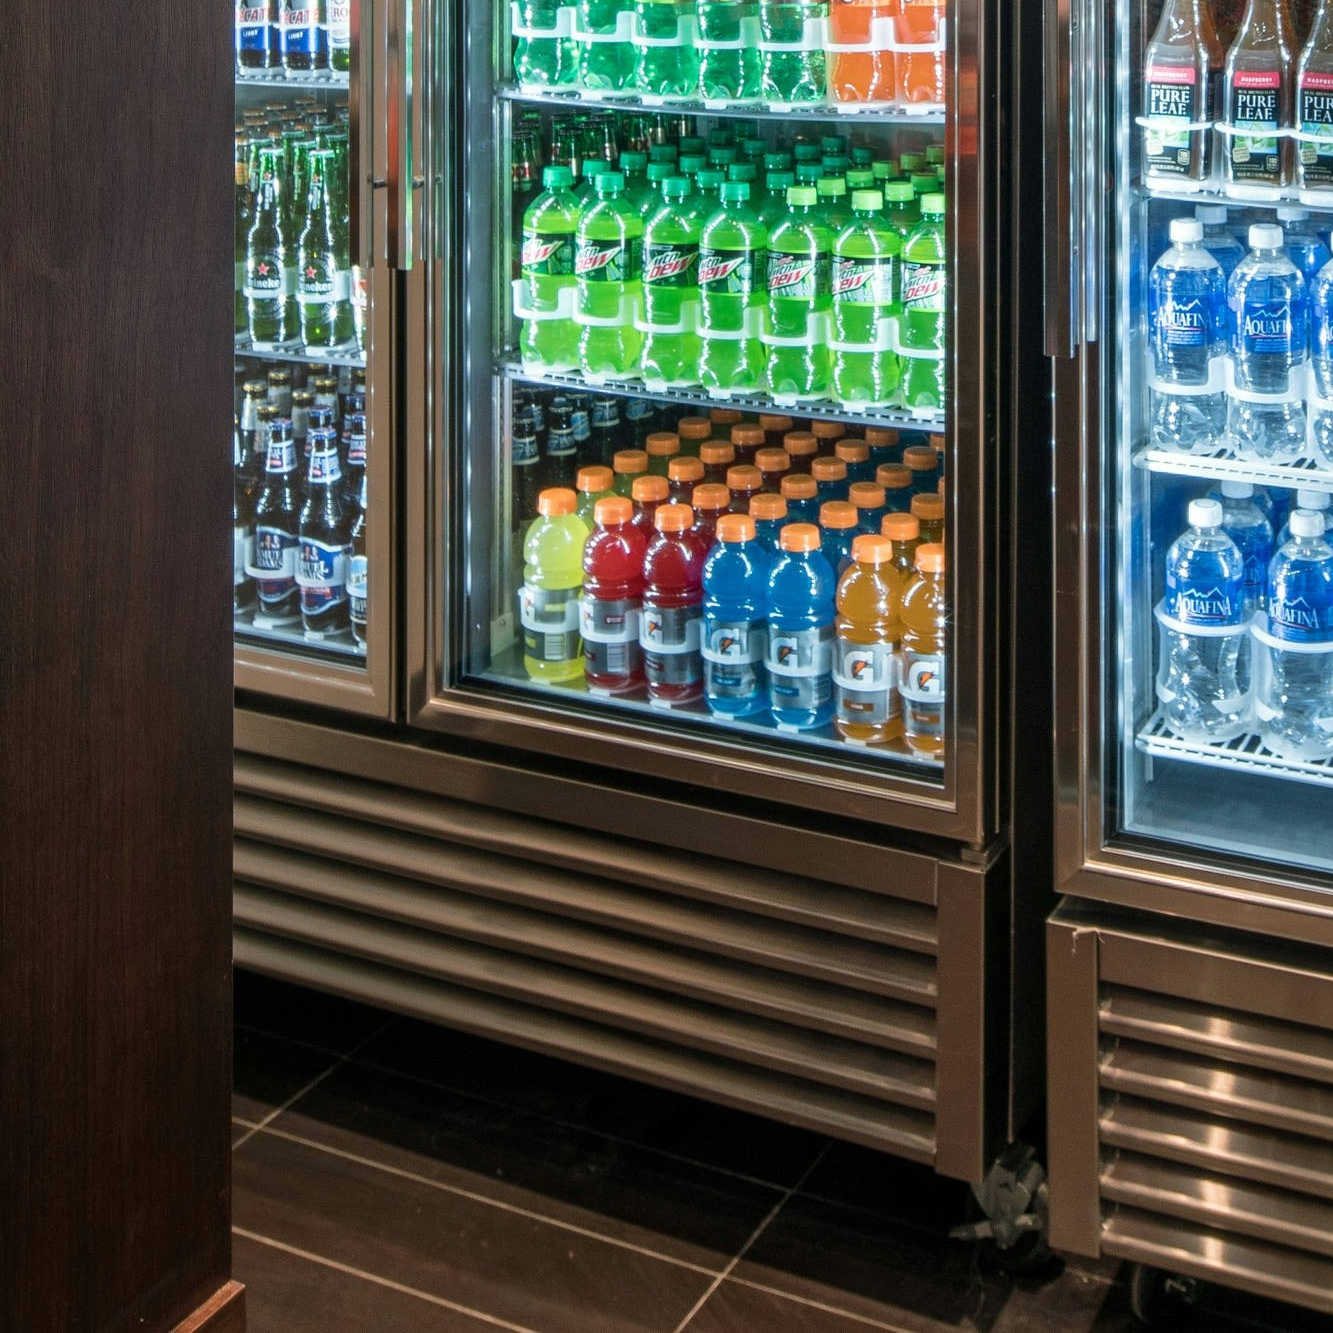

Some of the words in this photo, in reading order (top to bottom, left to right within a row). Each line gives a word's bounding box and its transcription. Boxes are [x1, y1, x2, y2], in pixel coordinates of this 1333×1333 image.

[1150, 89, 1190, 104] PURE
[1237, 94, 1276, 108] PURE
[845, 650, 874, 683] G
[909, 660, 940, 693] G
